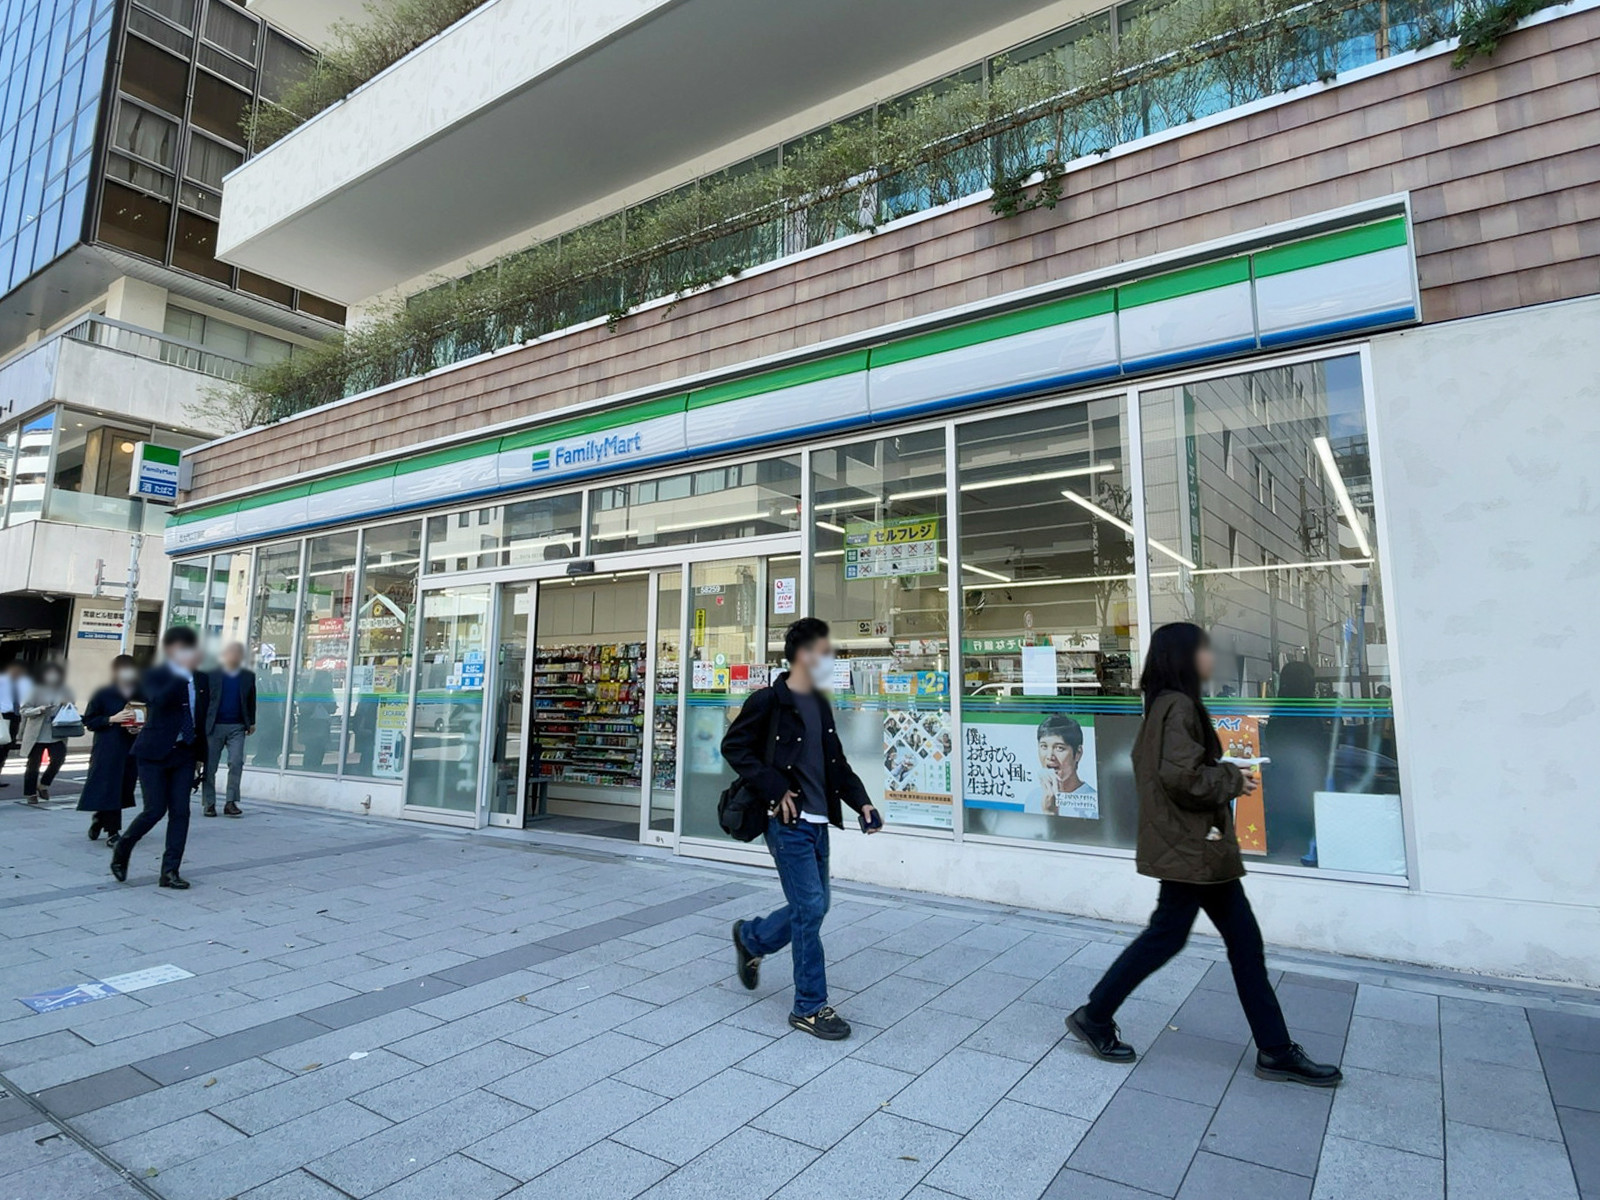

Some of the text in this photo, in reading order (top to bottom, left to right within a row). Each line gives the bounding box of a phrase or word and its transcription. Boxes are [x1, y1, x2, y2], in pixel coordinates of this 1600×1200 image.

[555, 431, 641, 467] FamilyMart
[142, 464, 177, 477] FamilyMart
[141, 482, 174, 495] 酒 たばこ
[873, 524, 932, 543] セルフレジ
[965, 727, 988, 746] 僕は
[967, 745, 1017, 764] おむすびの
[967, 762, 1033, 782] おいしい国に
[967, 779, 1016, 798] 生まれた。
